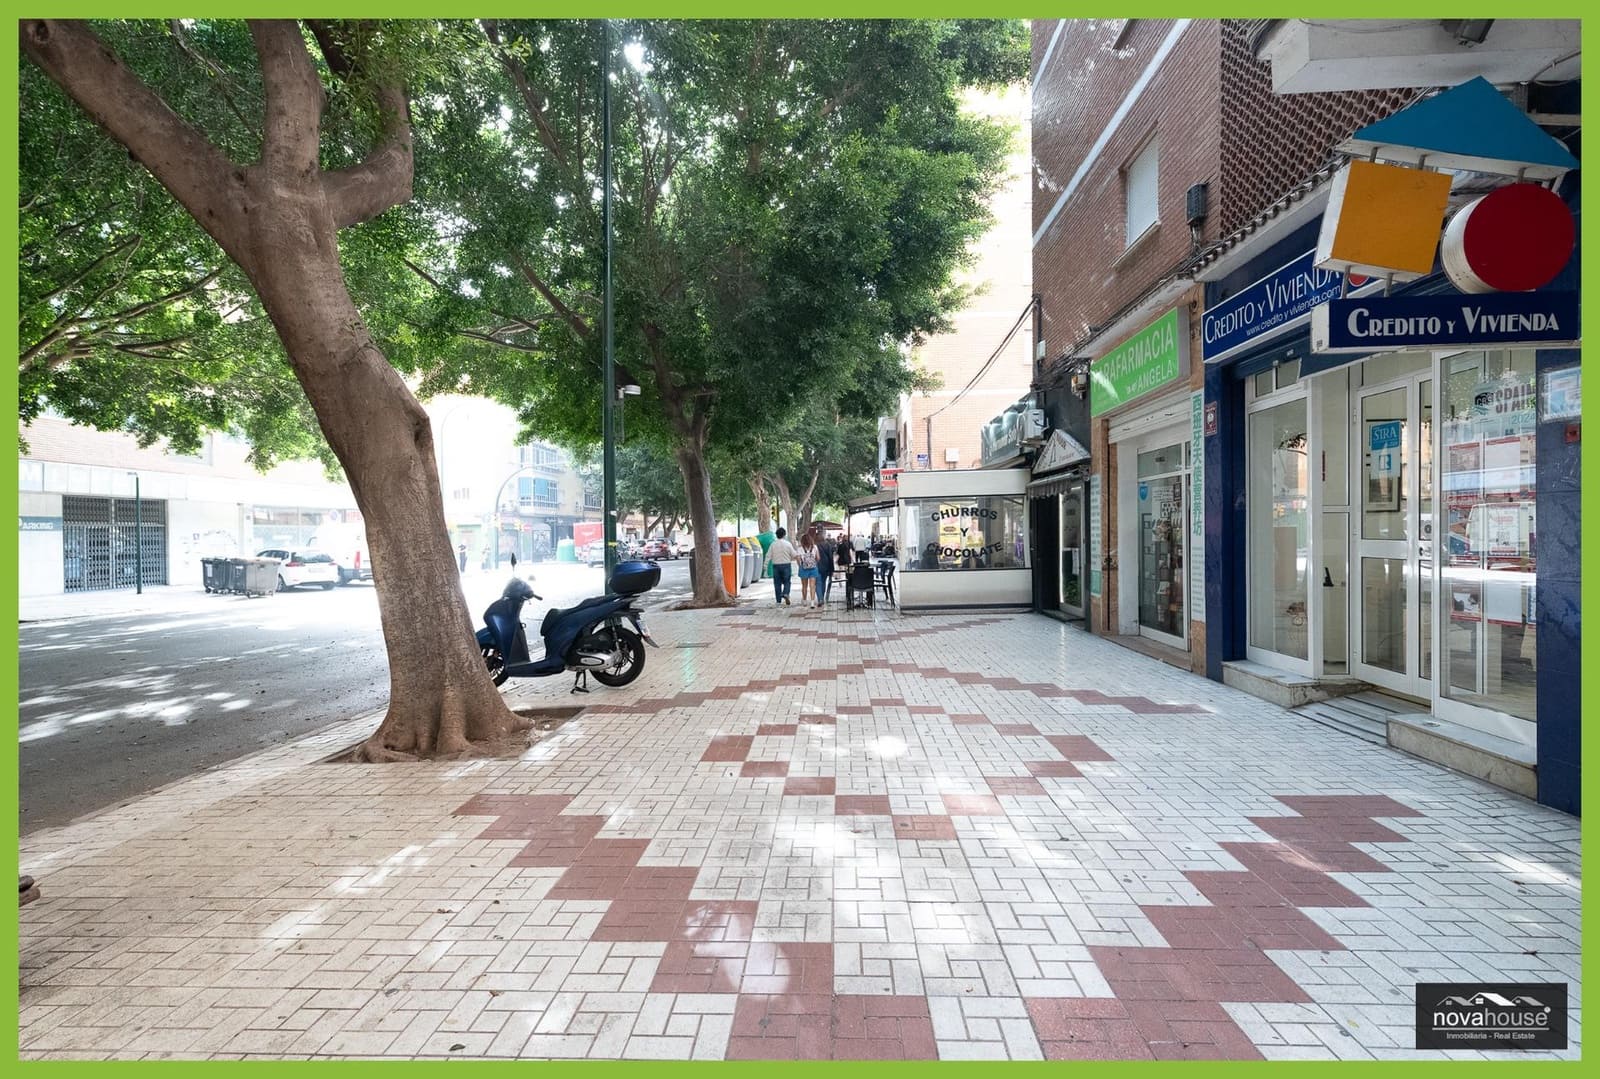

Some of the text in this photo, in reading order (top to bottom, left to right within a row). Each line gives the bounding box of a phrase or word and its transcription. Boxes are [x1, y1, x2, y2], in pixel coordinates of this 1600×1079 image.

[1204, 301, 1255, 344] CREDITO
[1347, 308, 1441, 338] CREDITO
[1461, 306, 1560, 334] VIVIENDA
[931, 507, 998, 522] CHURROS
[960, 527, 969, 537] Y
[926, 541, 1004, 558] CHOCOLATE
